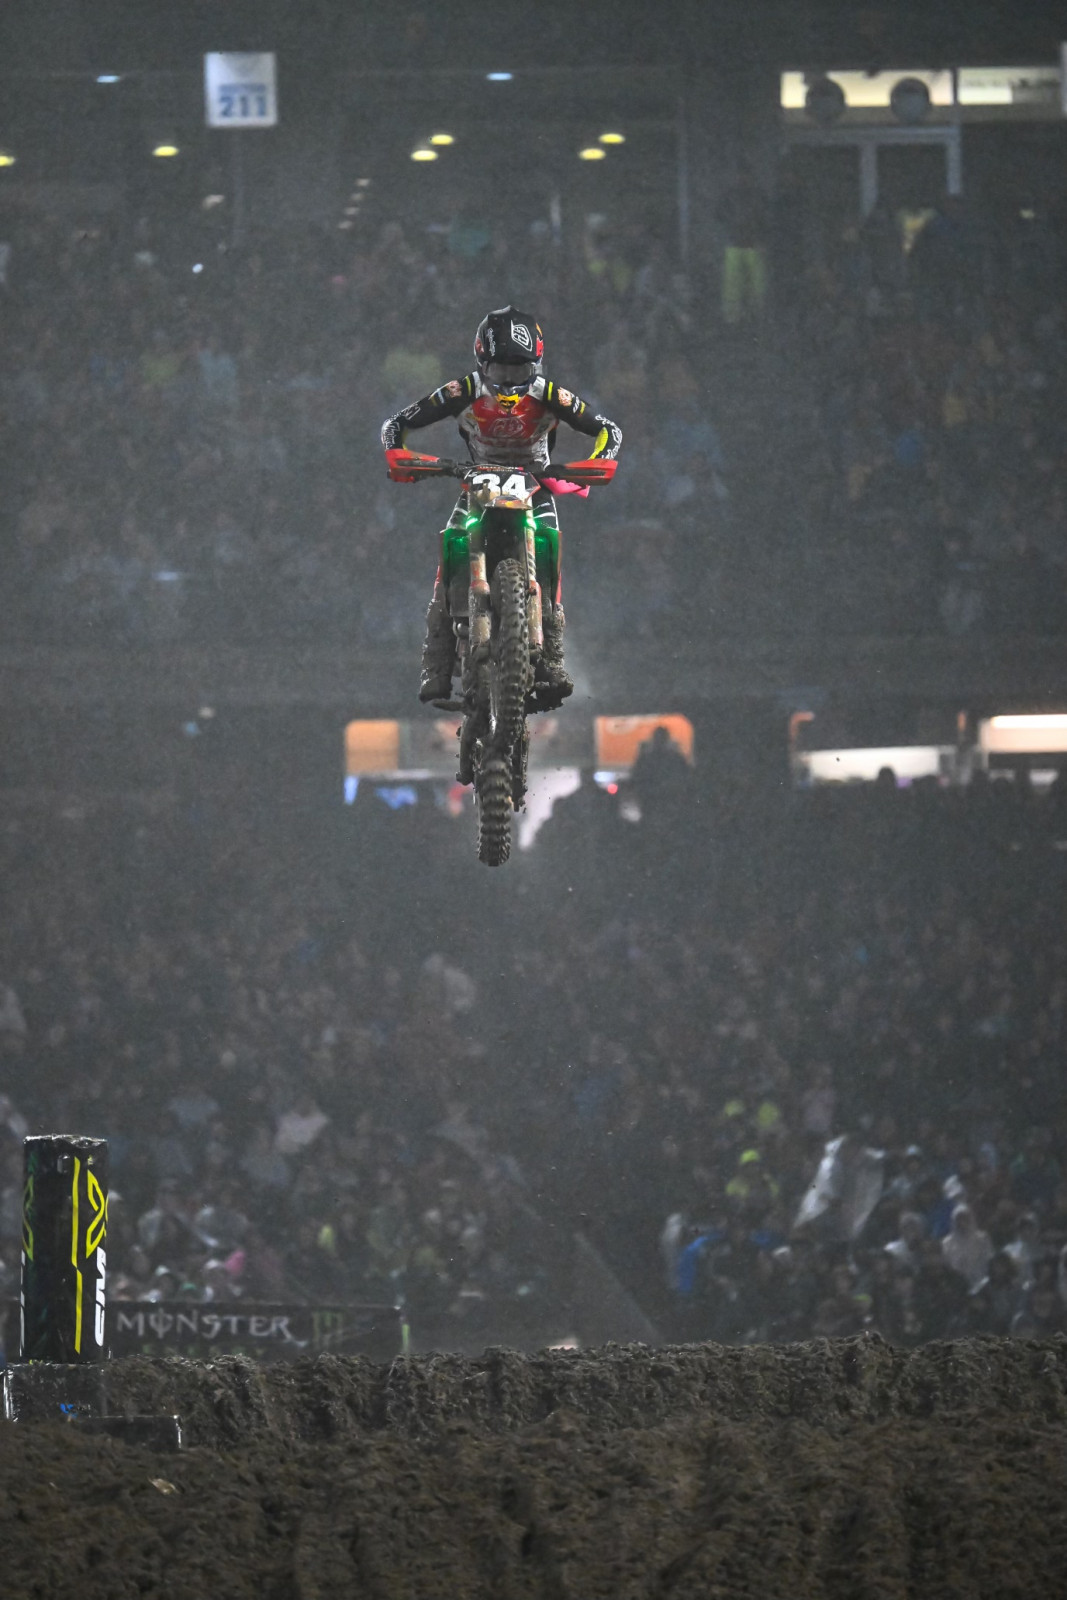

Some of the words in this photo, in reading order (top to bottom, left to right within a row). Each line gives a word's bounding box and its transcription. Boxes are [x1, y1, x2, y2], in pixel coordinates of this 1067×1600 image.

[219, 96, 266, 118] 211
[473, 473, 530, 503] 34
[116, 1307, 308, 1347] MONSTER
